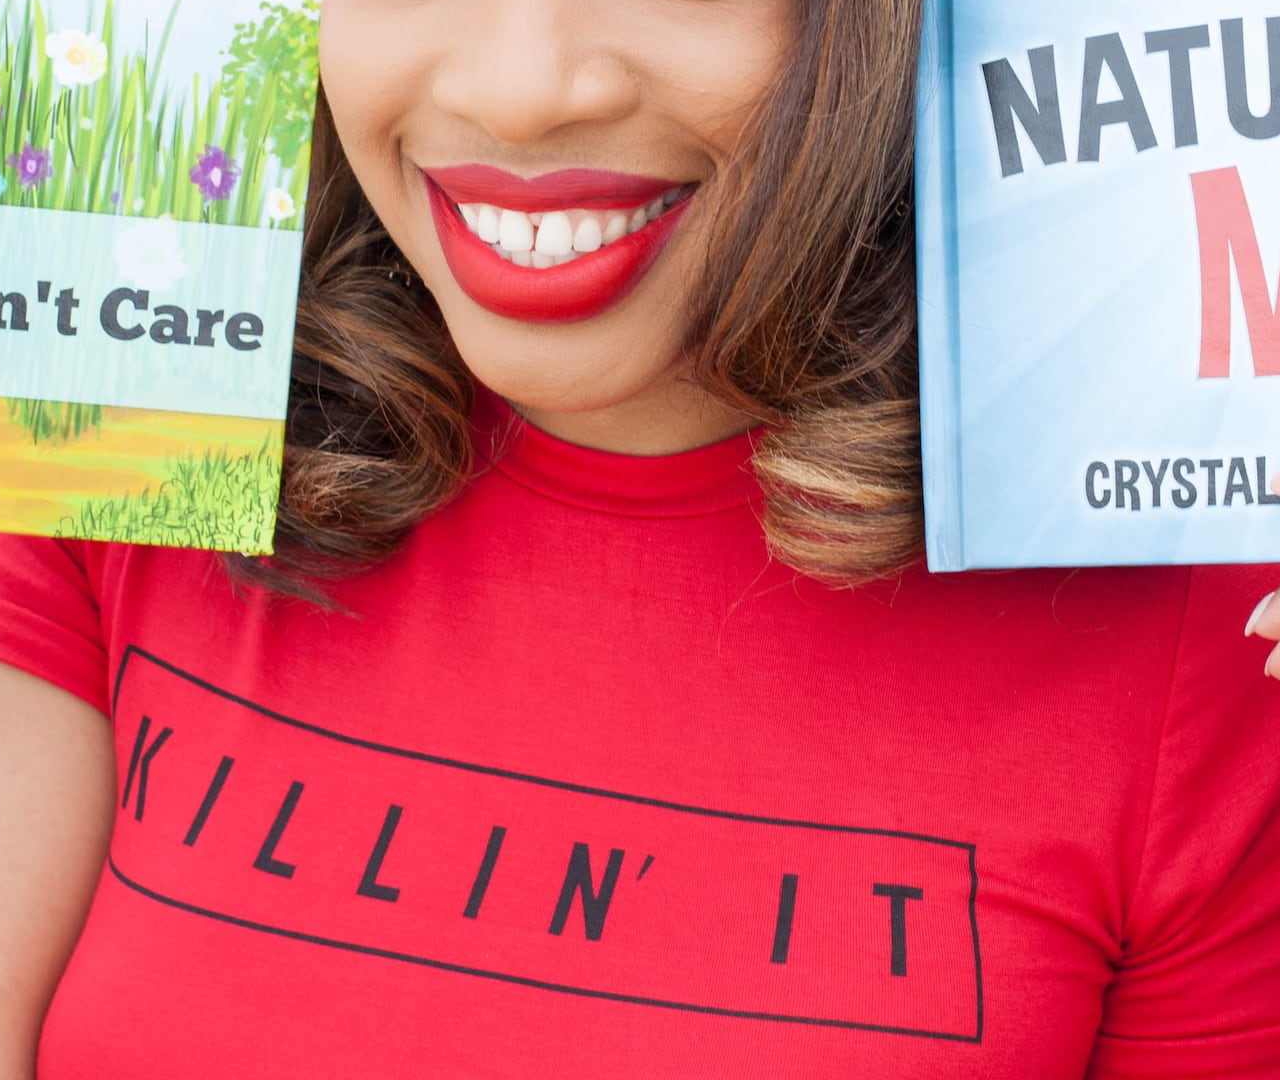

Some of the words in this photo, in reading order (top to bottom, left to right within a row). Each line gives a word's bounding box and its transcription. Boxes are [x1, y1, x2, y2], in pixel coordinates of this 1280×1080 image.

[99, 287, 264, 351] Care
[121, 715, 656, 941] KILLIN'
[771, 873, 924, 977] IT
